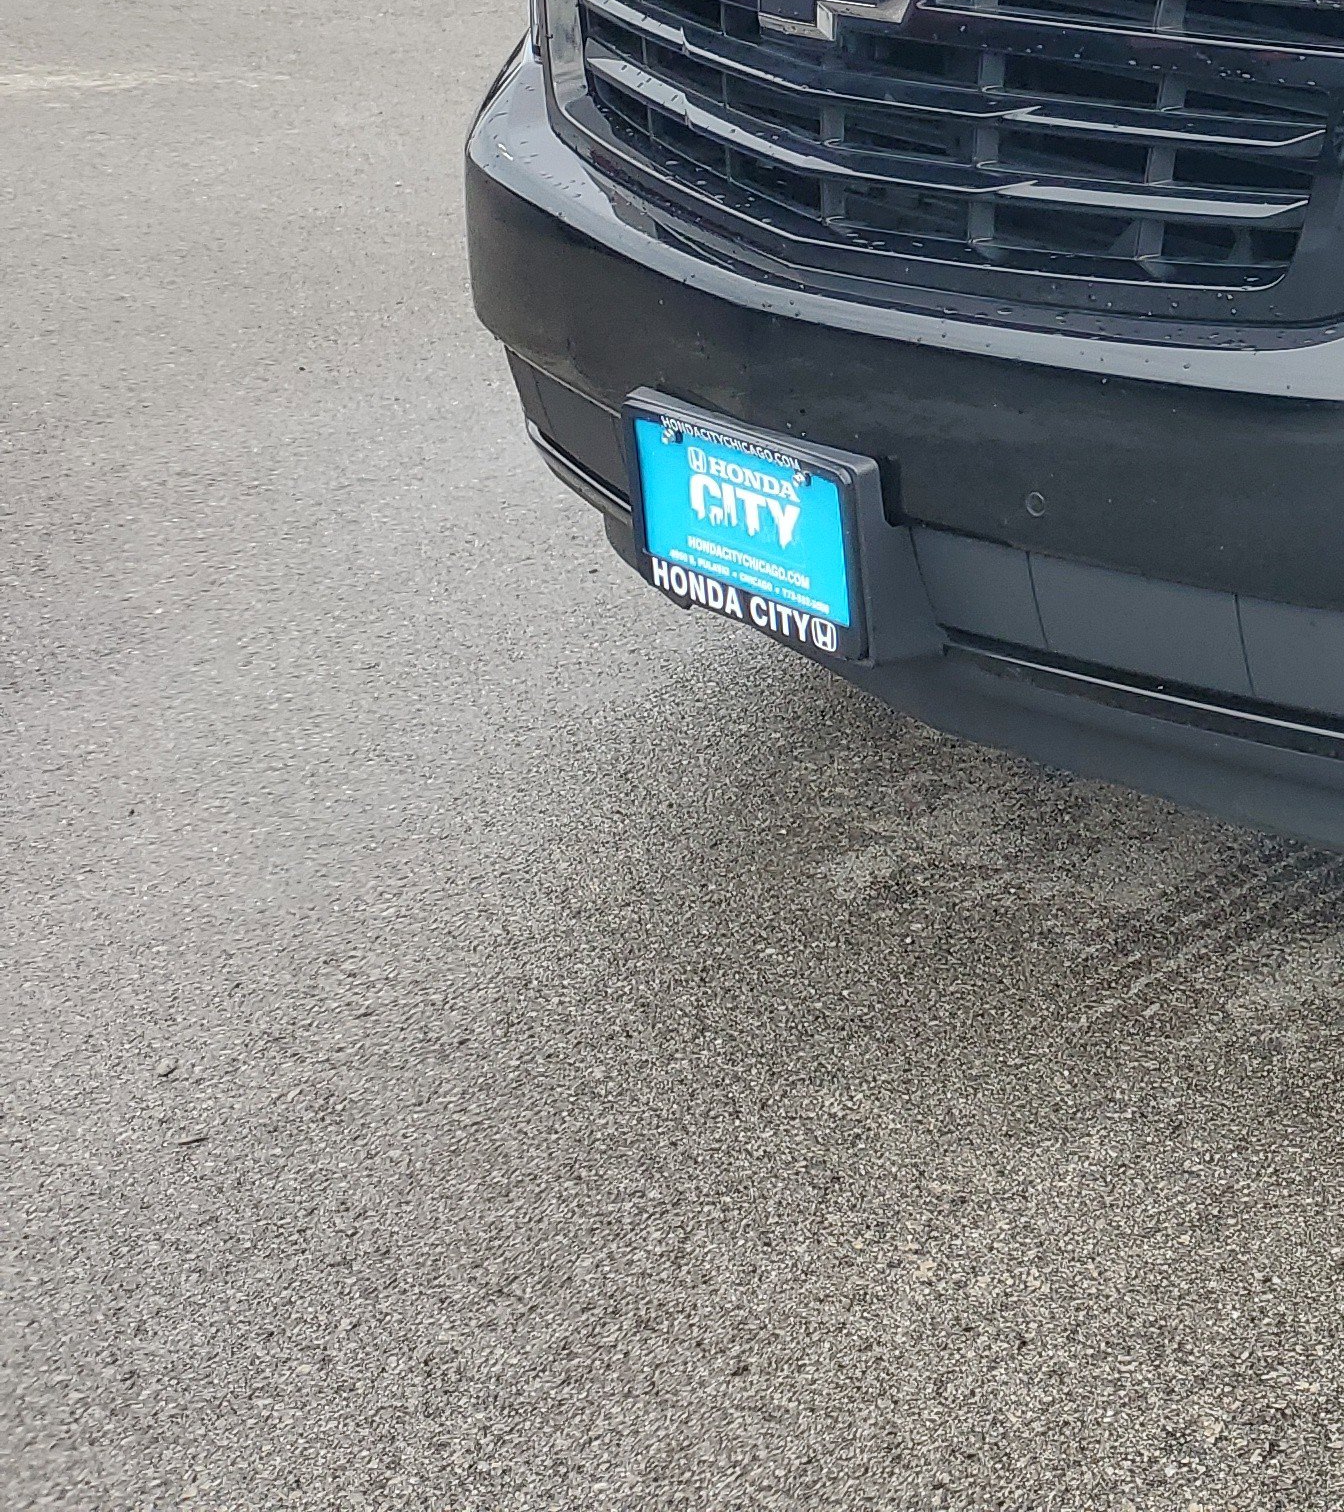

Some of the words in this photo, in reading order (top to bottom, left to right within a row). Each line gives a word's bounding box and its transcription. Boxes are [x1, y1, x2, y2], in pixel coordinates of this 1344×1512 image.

[660, 415, 802, 472] HONDACITYCHICAGO.COM
[707, 456, 801, 503] HONDA
[689, 473, 801, 550] CITY
[686, 535, 811, 591] HONDACITYCHICAGO.COM
[651, 556, 744, 619] HONDA
[749, 596, 811, 643] CITY
